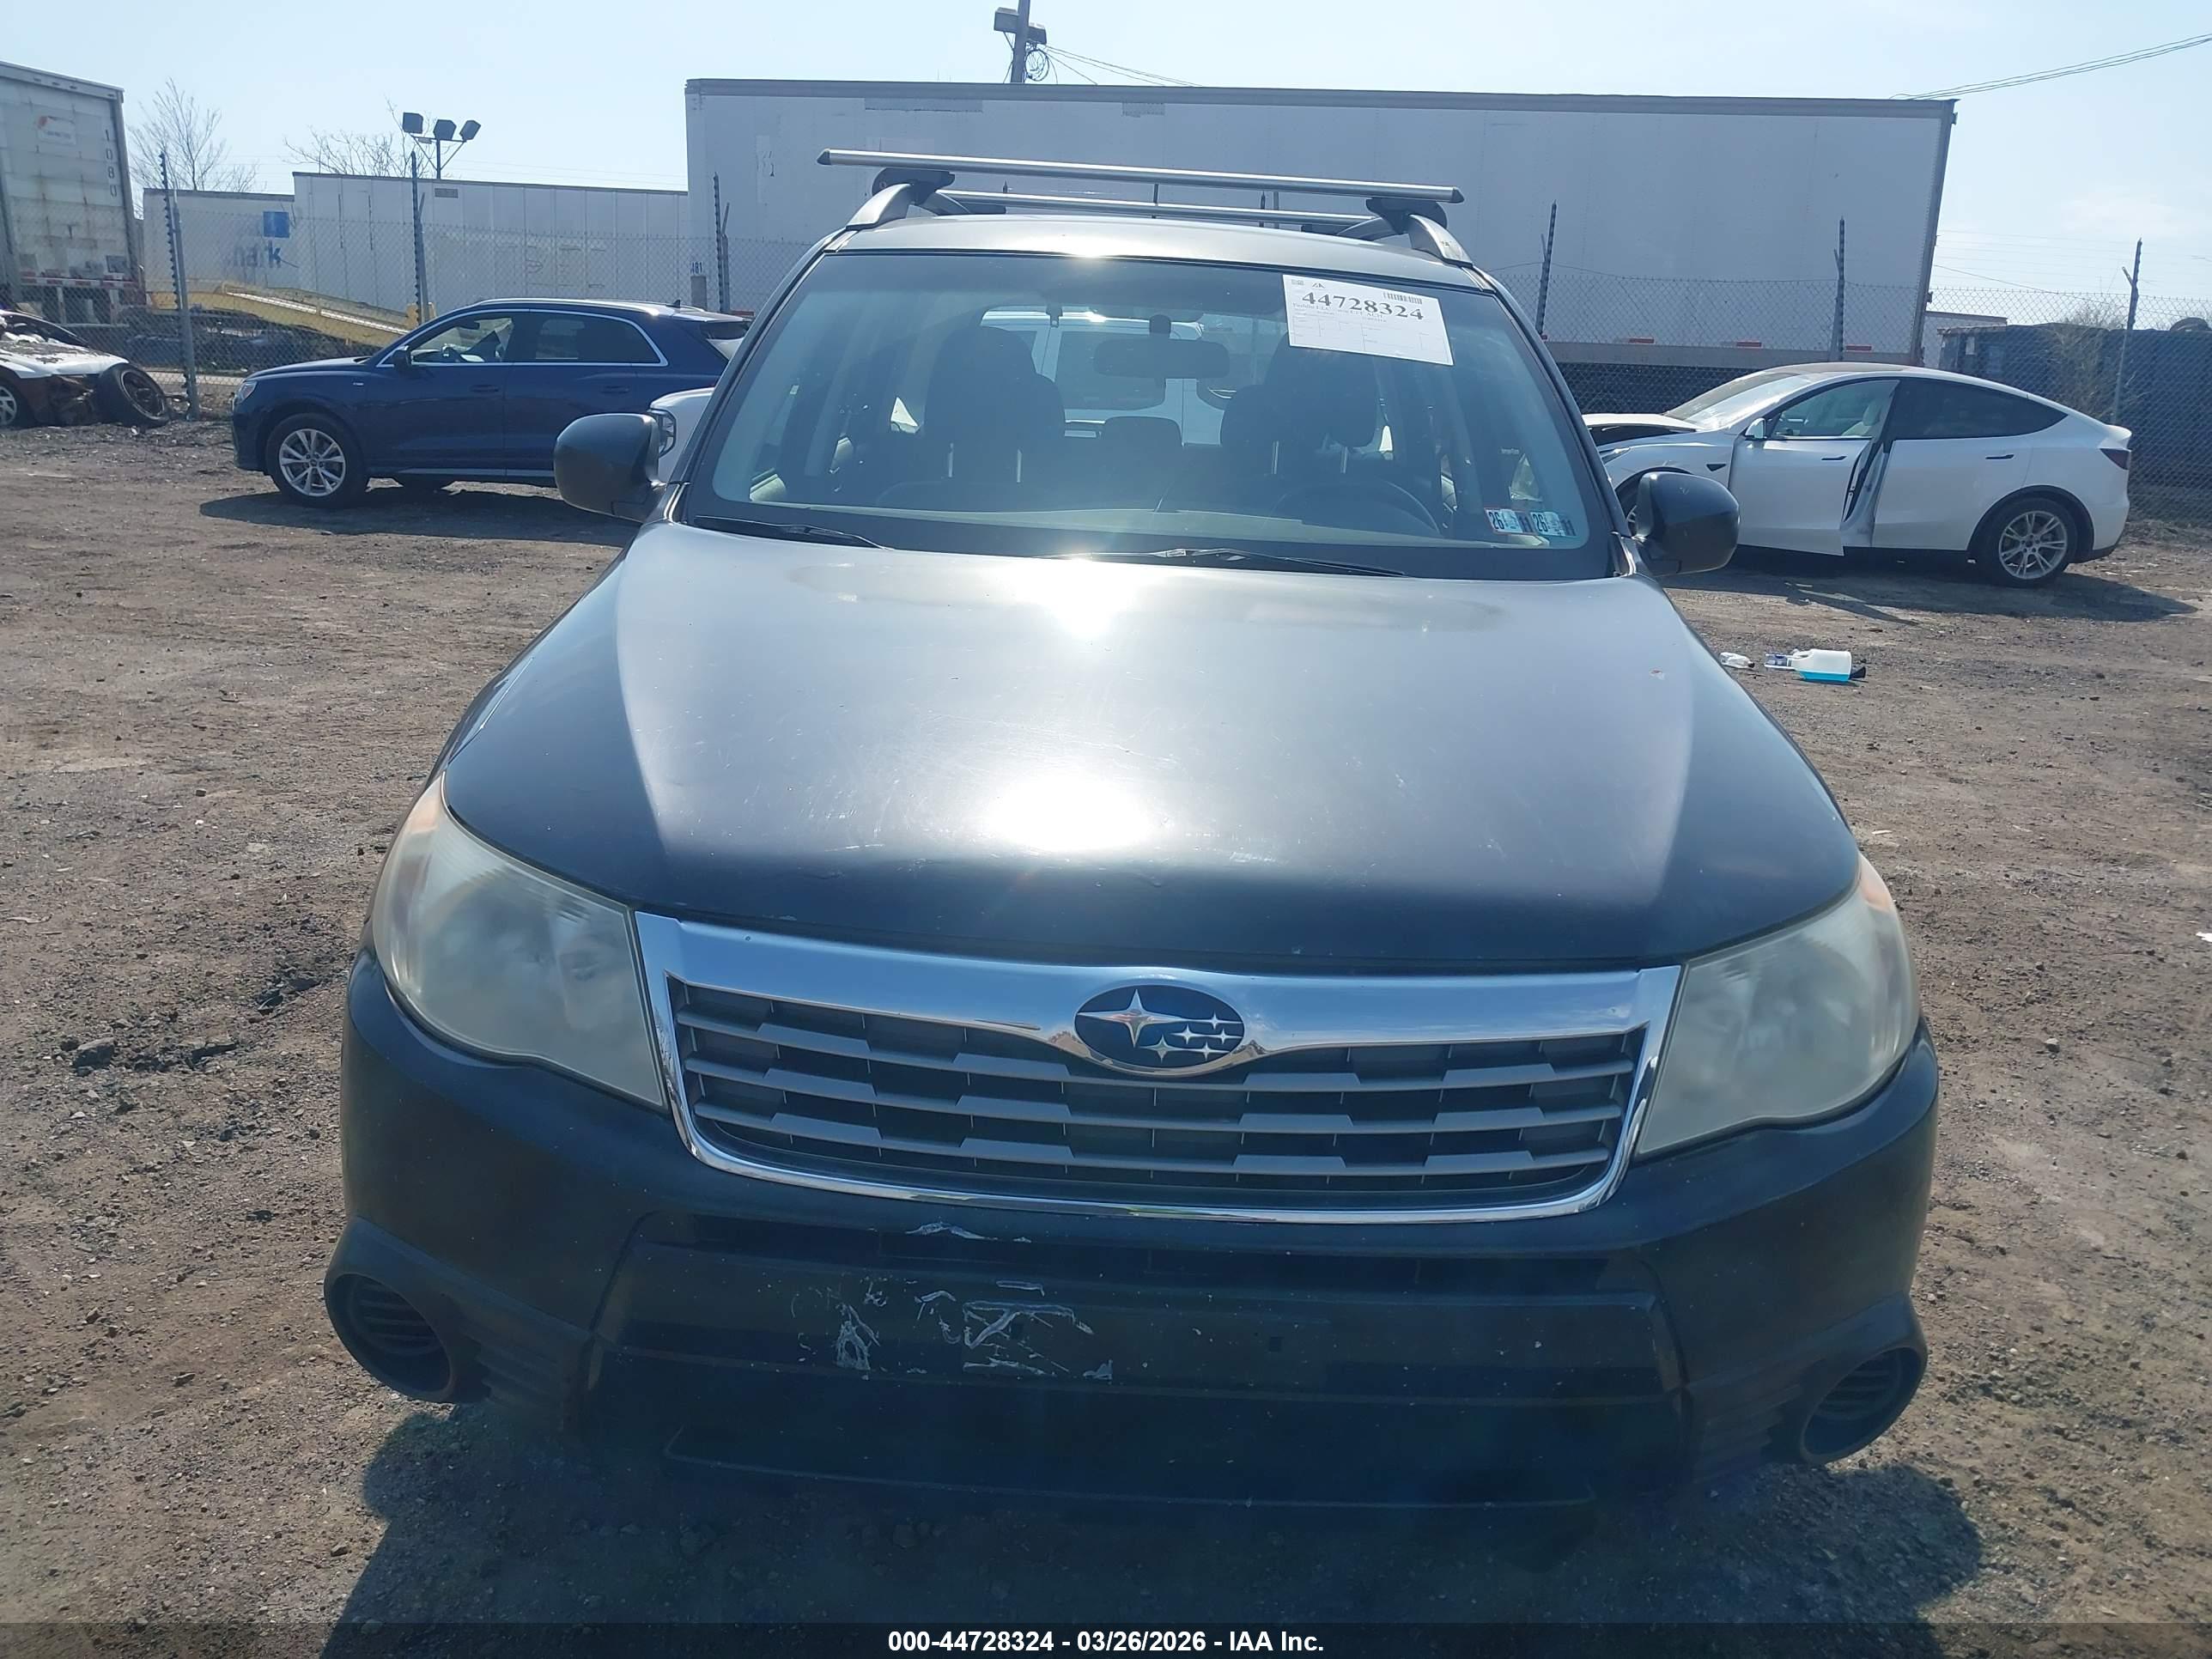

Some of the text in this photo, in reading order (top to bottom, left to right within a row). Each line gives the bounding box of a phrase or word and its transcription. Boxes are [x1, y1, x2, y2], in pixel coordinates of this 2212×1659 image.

[1302, 291, 1424, 320] 44728324
[1488, 511, 1504, 530] 26
[1533, 514, 1548, 532] 26
